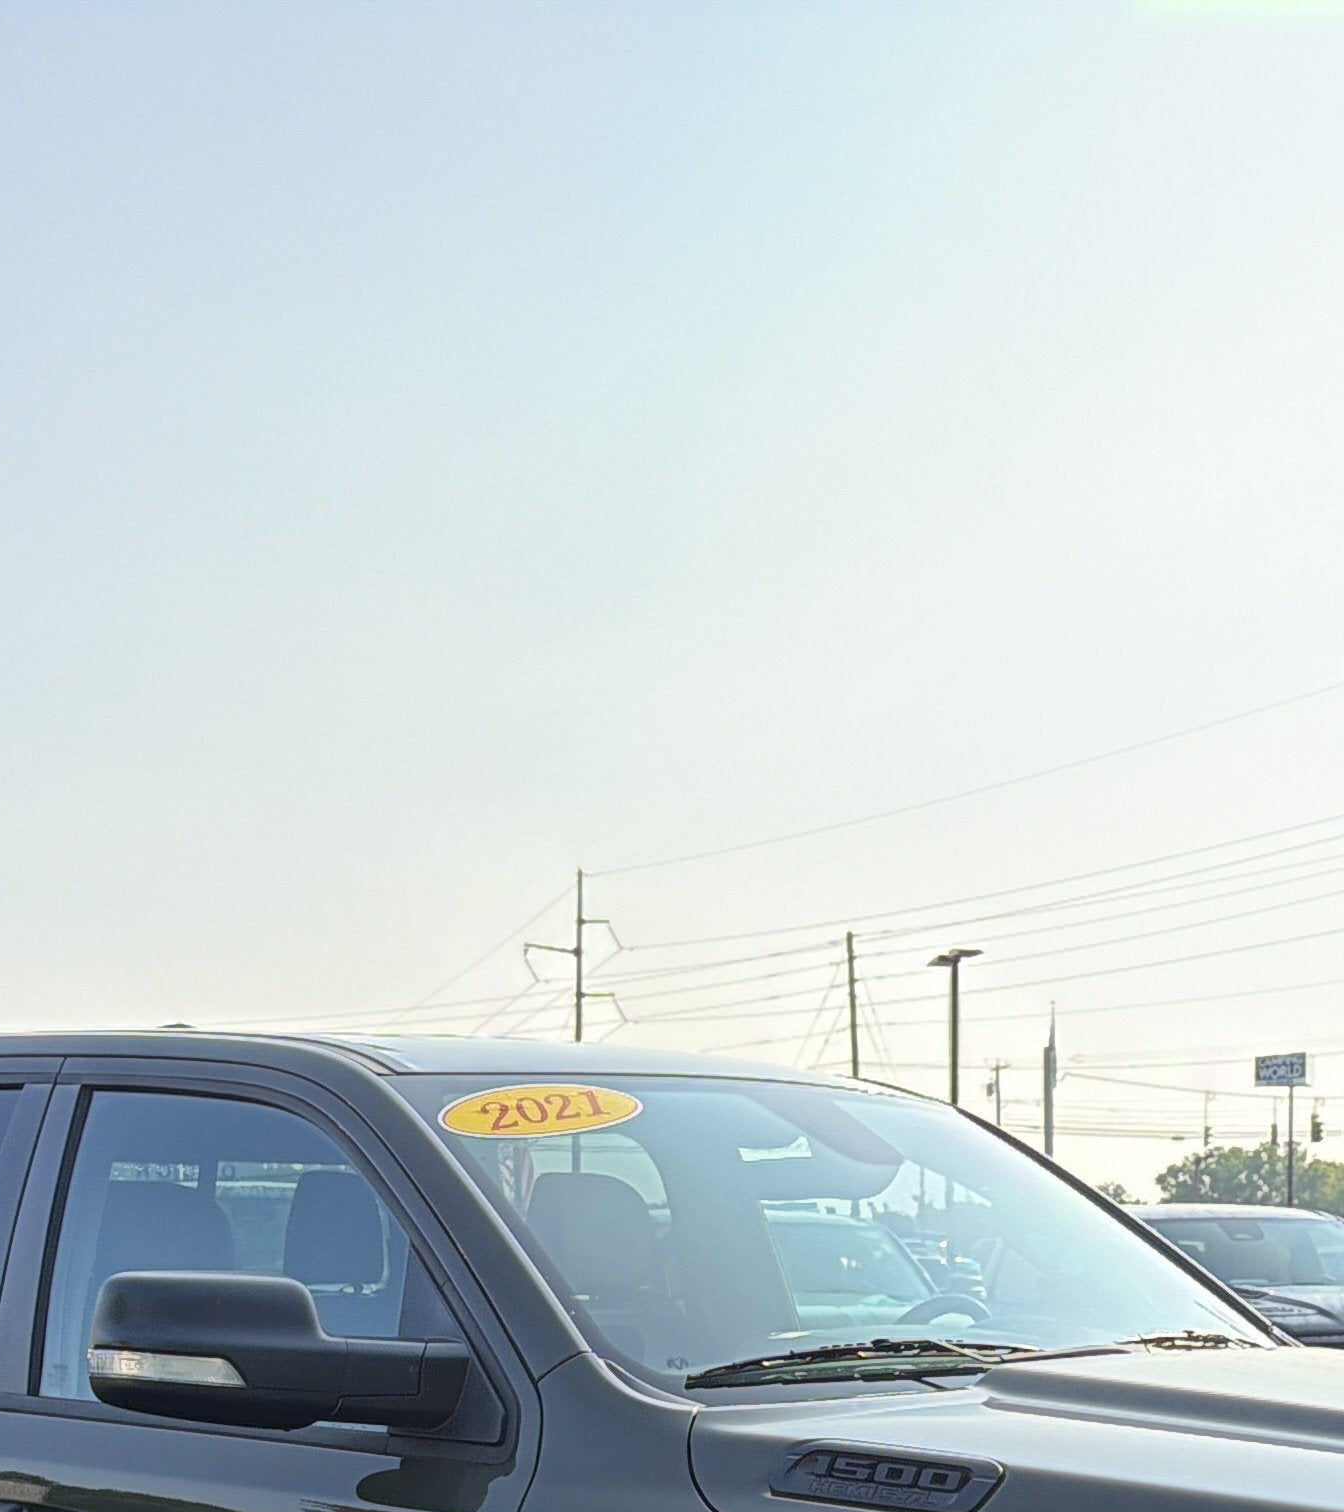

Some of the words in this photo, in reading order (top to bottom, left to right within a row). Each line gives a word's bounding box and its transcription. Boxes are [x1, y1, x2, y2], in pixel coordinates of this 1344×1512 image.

[1258, 1063, 1303, 1080] WORLD
[480, 1089, 611, 1131] 2021
[804, 1454, 962, 1492] 1500
[809, 1477, 878, 1499] HEMI
